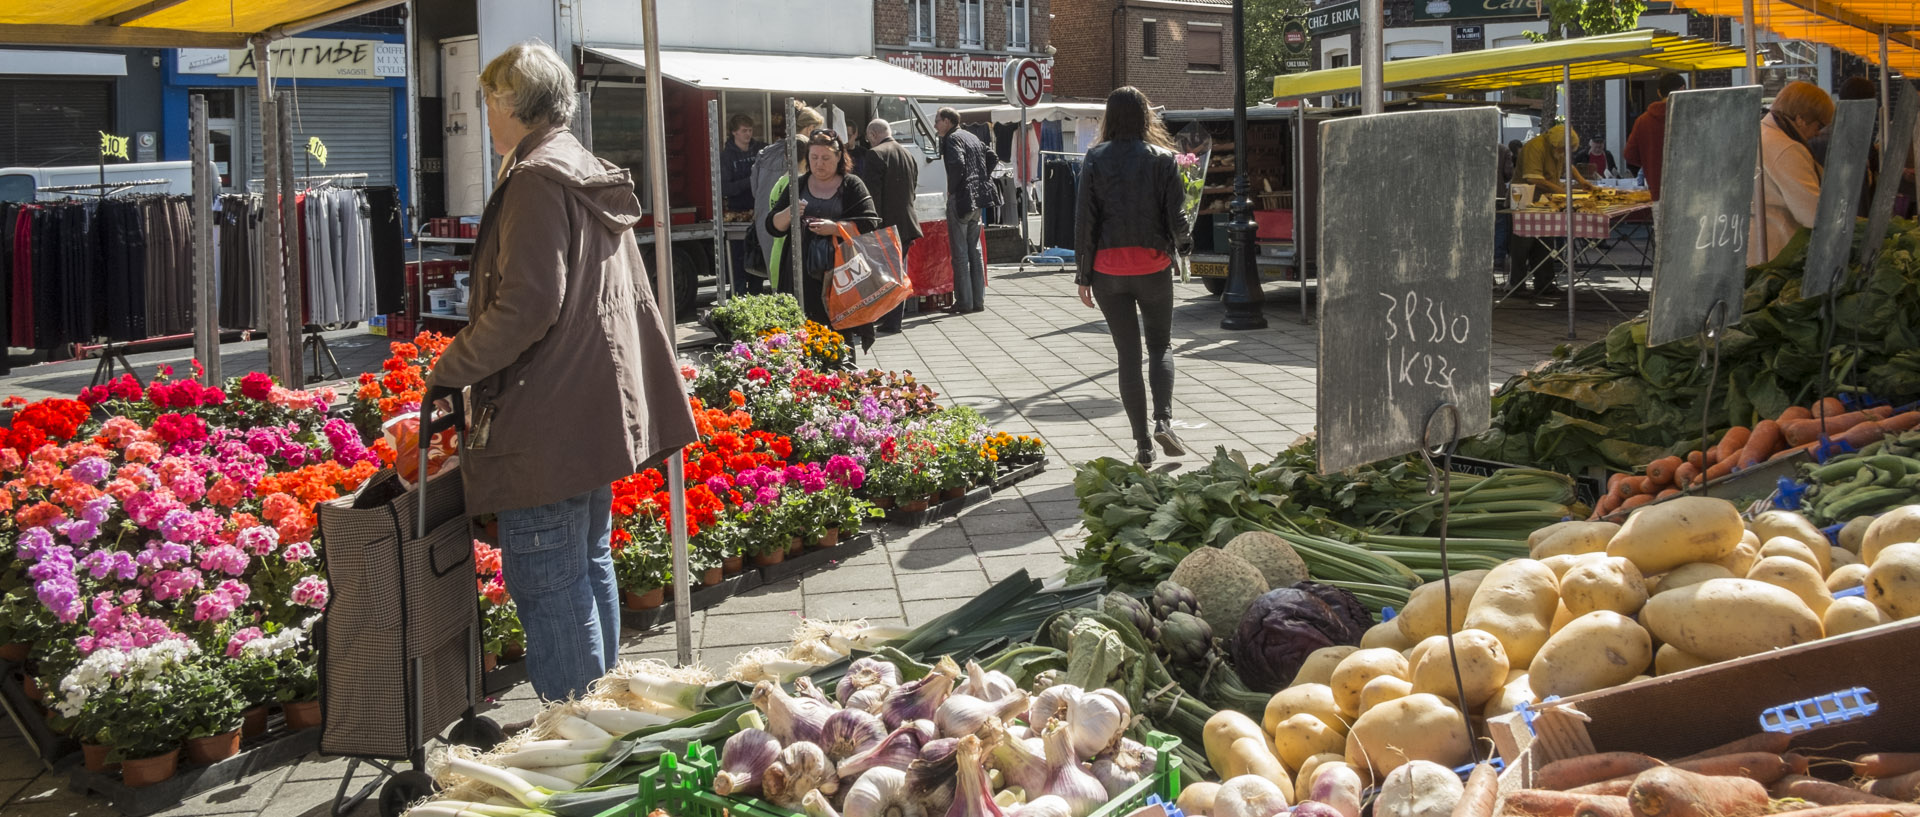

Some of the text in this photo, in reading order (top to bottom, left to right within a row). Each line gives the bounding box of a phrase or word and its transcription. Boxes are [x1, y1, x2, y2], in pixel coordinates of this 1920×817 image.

[1308, 7, 1360, 29] CHEZ ERIKA
[236, 41, 368, 75] ATITUDE
[376, 46, 405, 55] COIFFE
[336, 68, 368, 76] VISAGISTE
[959, 80, 990, 89] TRAITEUR
[108, 137, 120, 154] 10
[313, 141, 324, 158] 10
[833, 258, 869, 290] UM
